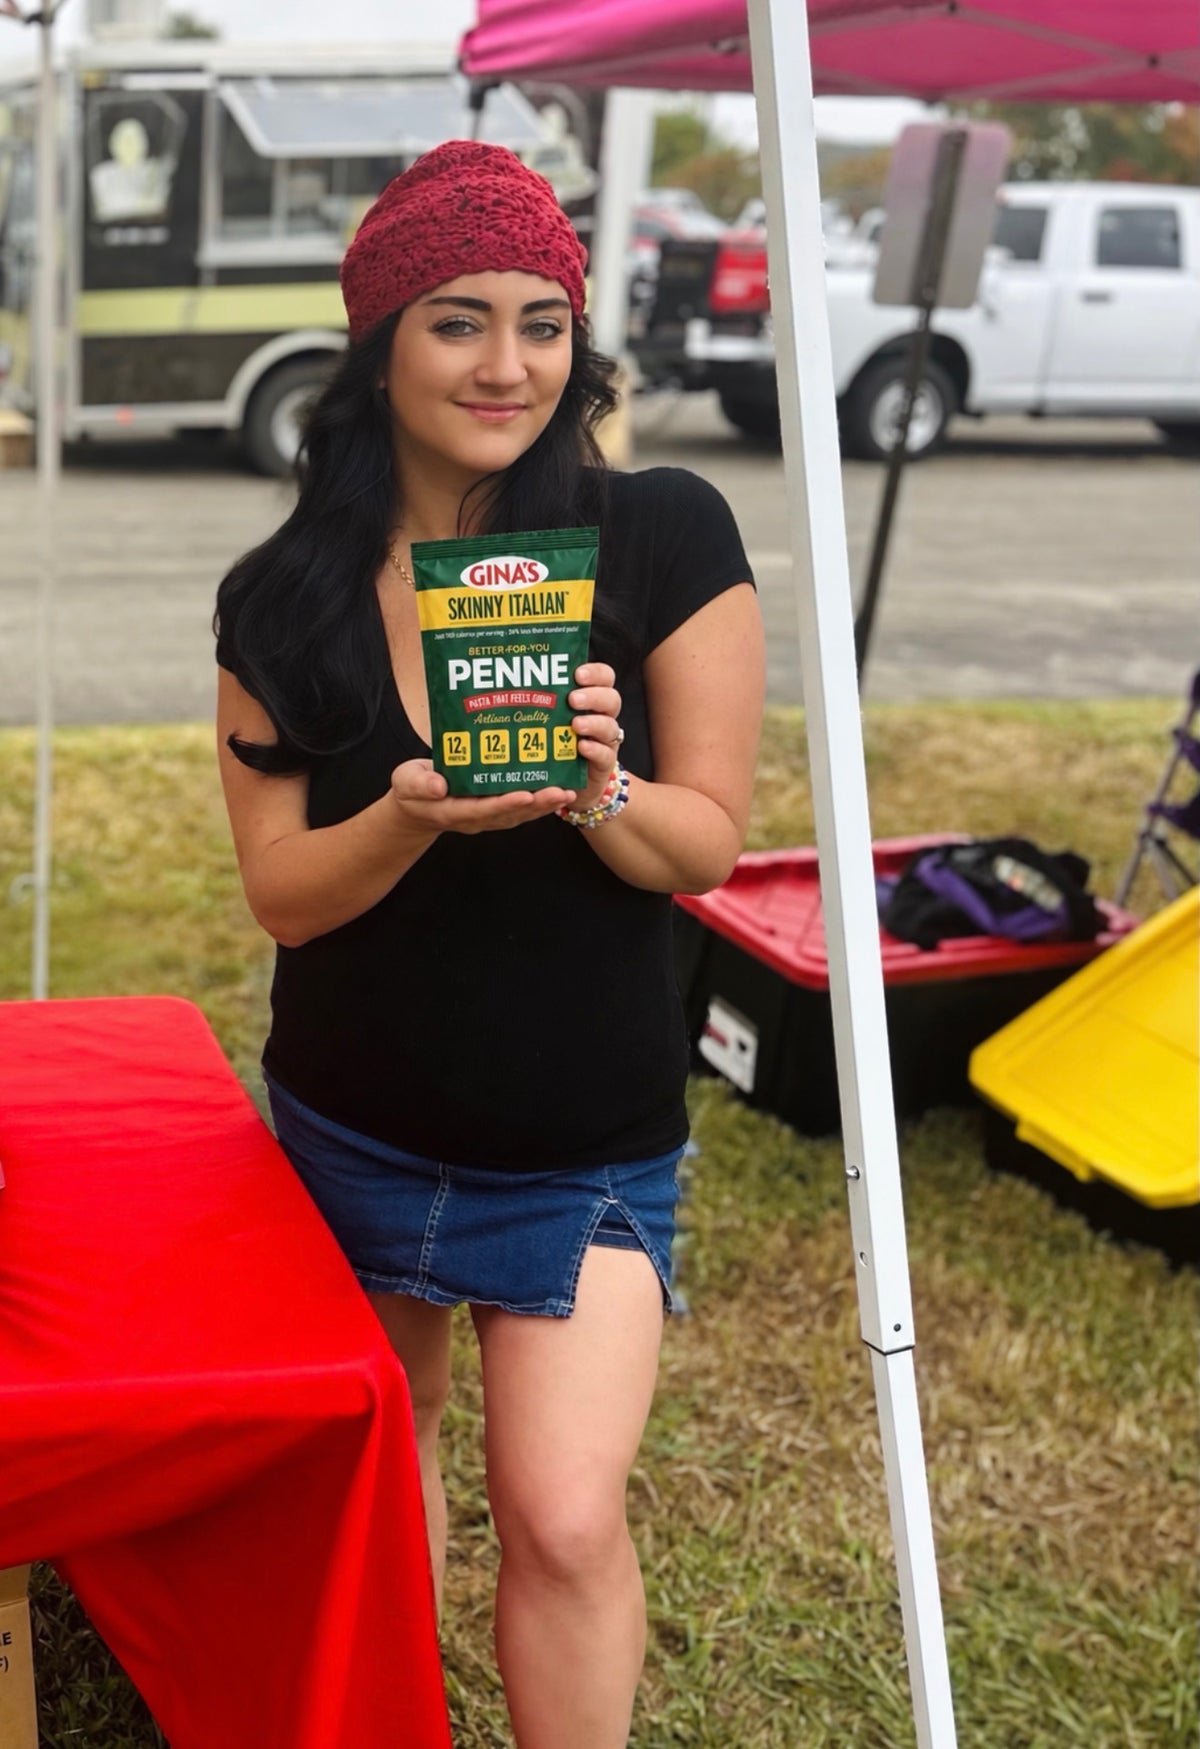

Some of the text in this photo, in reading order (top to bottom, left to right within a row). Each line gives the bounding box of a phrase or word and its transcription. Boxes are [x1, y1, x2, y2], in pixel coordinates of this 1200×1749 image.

[469, 562, 540, 586] GINA'S
[448, 594, 504, 620] SKINNY
[447, 654, 569, 690] PENNE
[468, 696, 491, 709] PASTA
[493, 693, 509, 705] THAT
[510, 693, 531, 704] FEELS
[473, 710, 551, 725] Artisan Quality
[473, 773, 488, 784] NET
[490, 772, 505, 783] WT.
